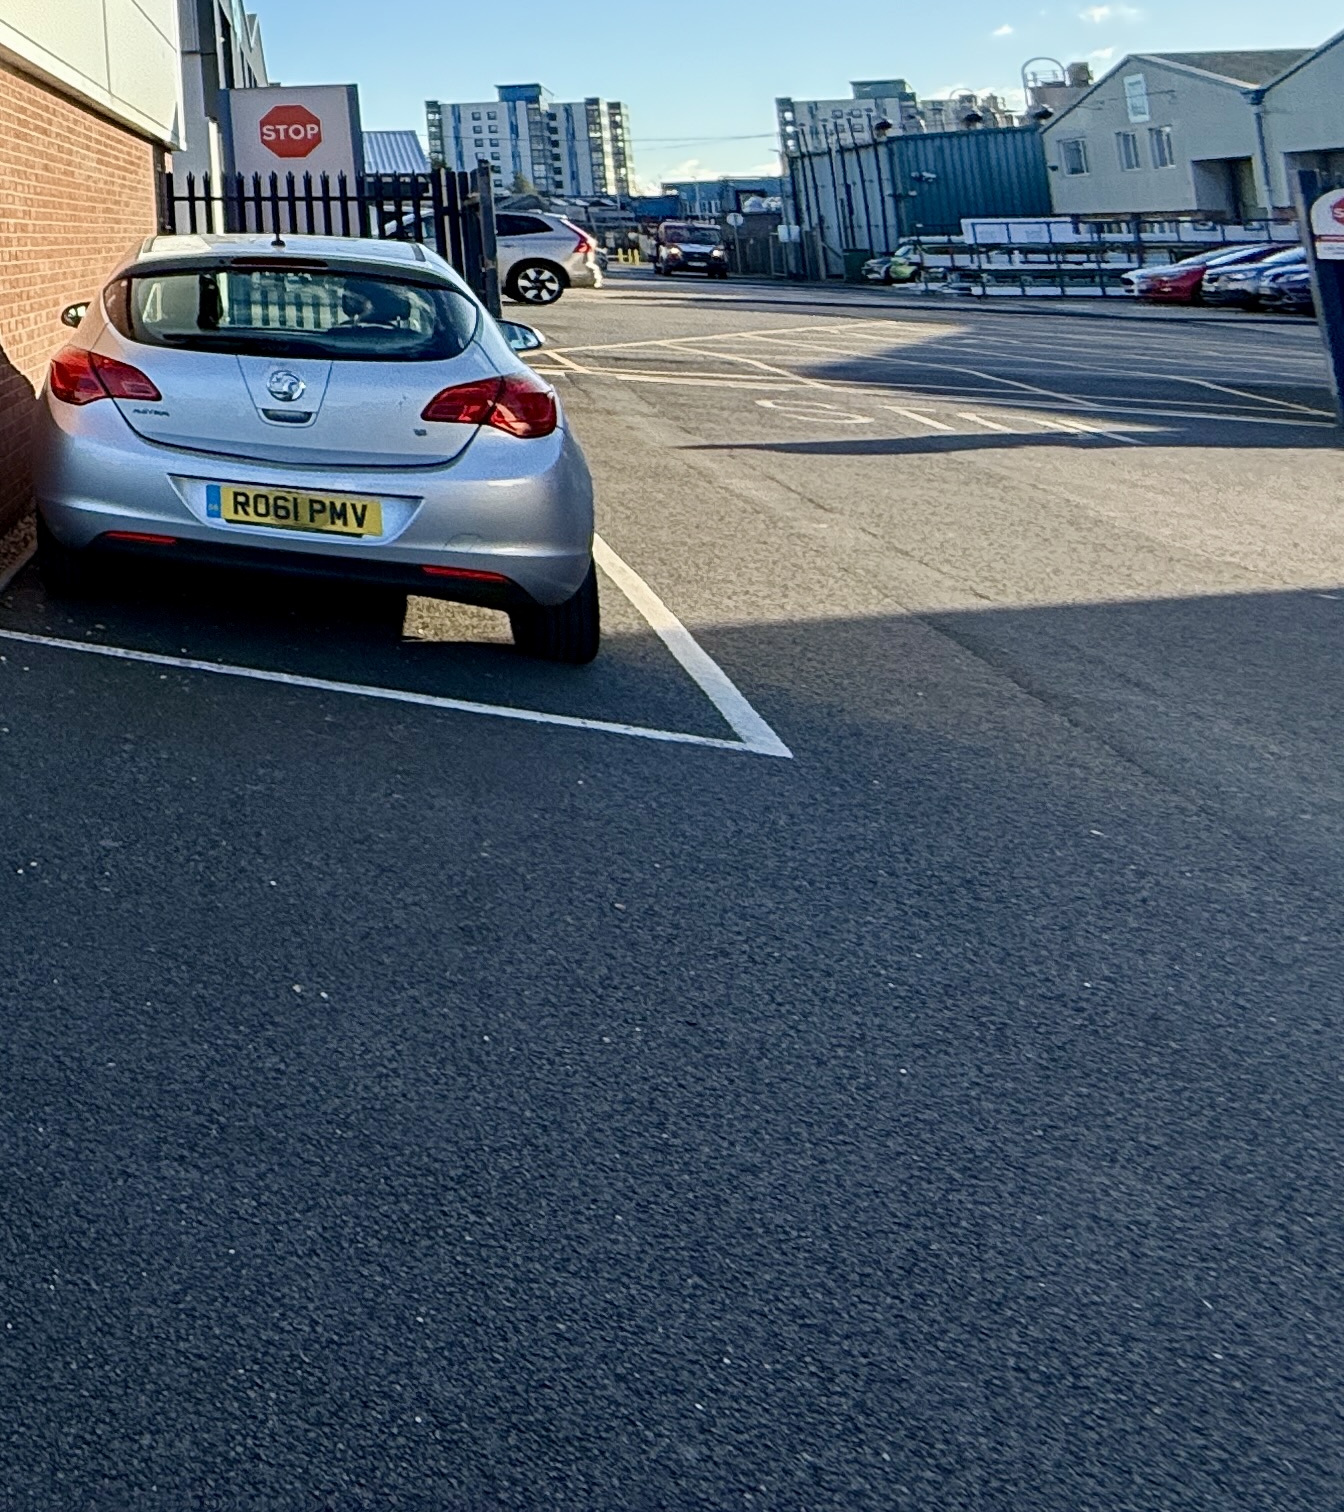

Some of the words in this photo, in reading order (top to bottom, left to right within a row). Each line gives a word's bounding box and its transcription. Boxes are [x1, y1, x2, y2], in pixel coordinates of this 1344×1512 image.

[262, 124, 319, 141] STOP
[232, 491, 300, 522] RO61
[309, 499, 368, 529] PMV
